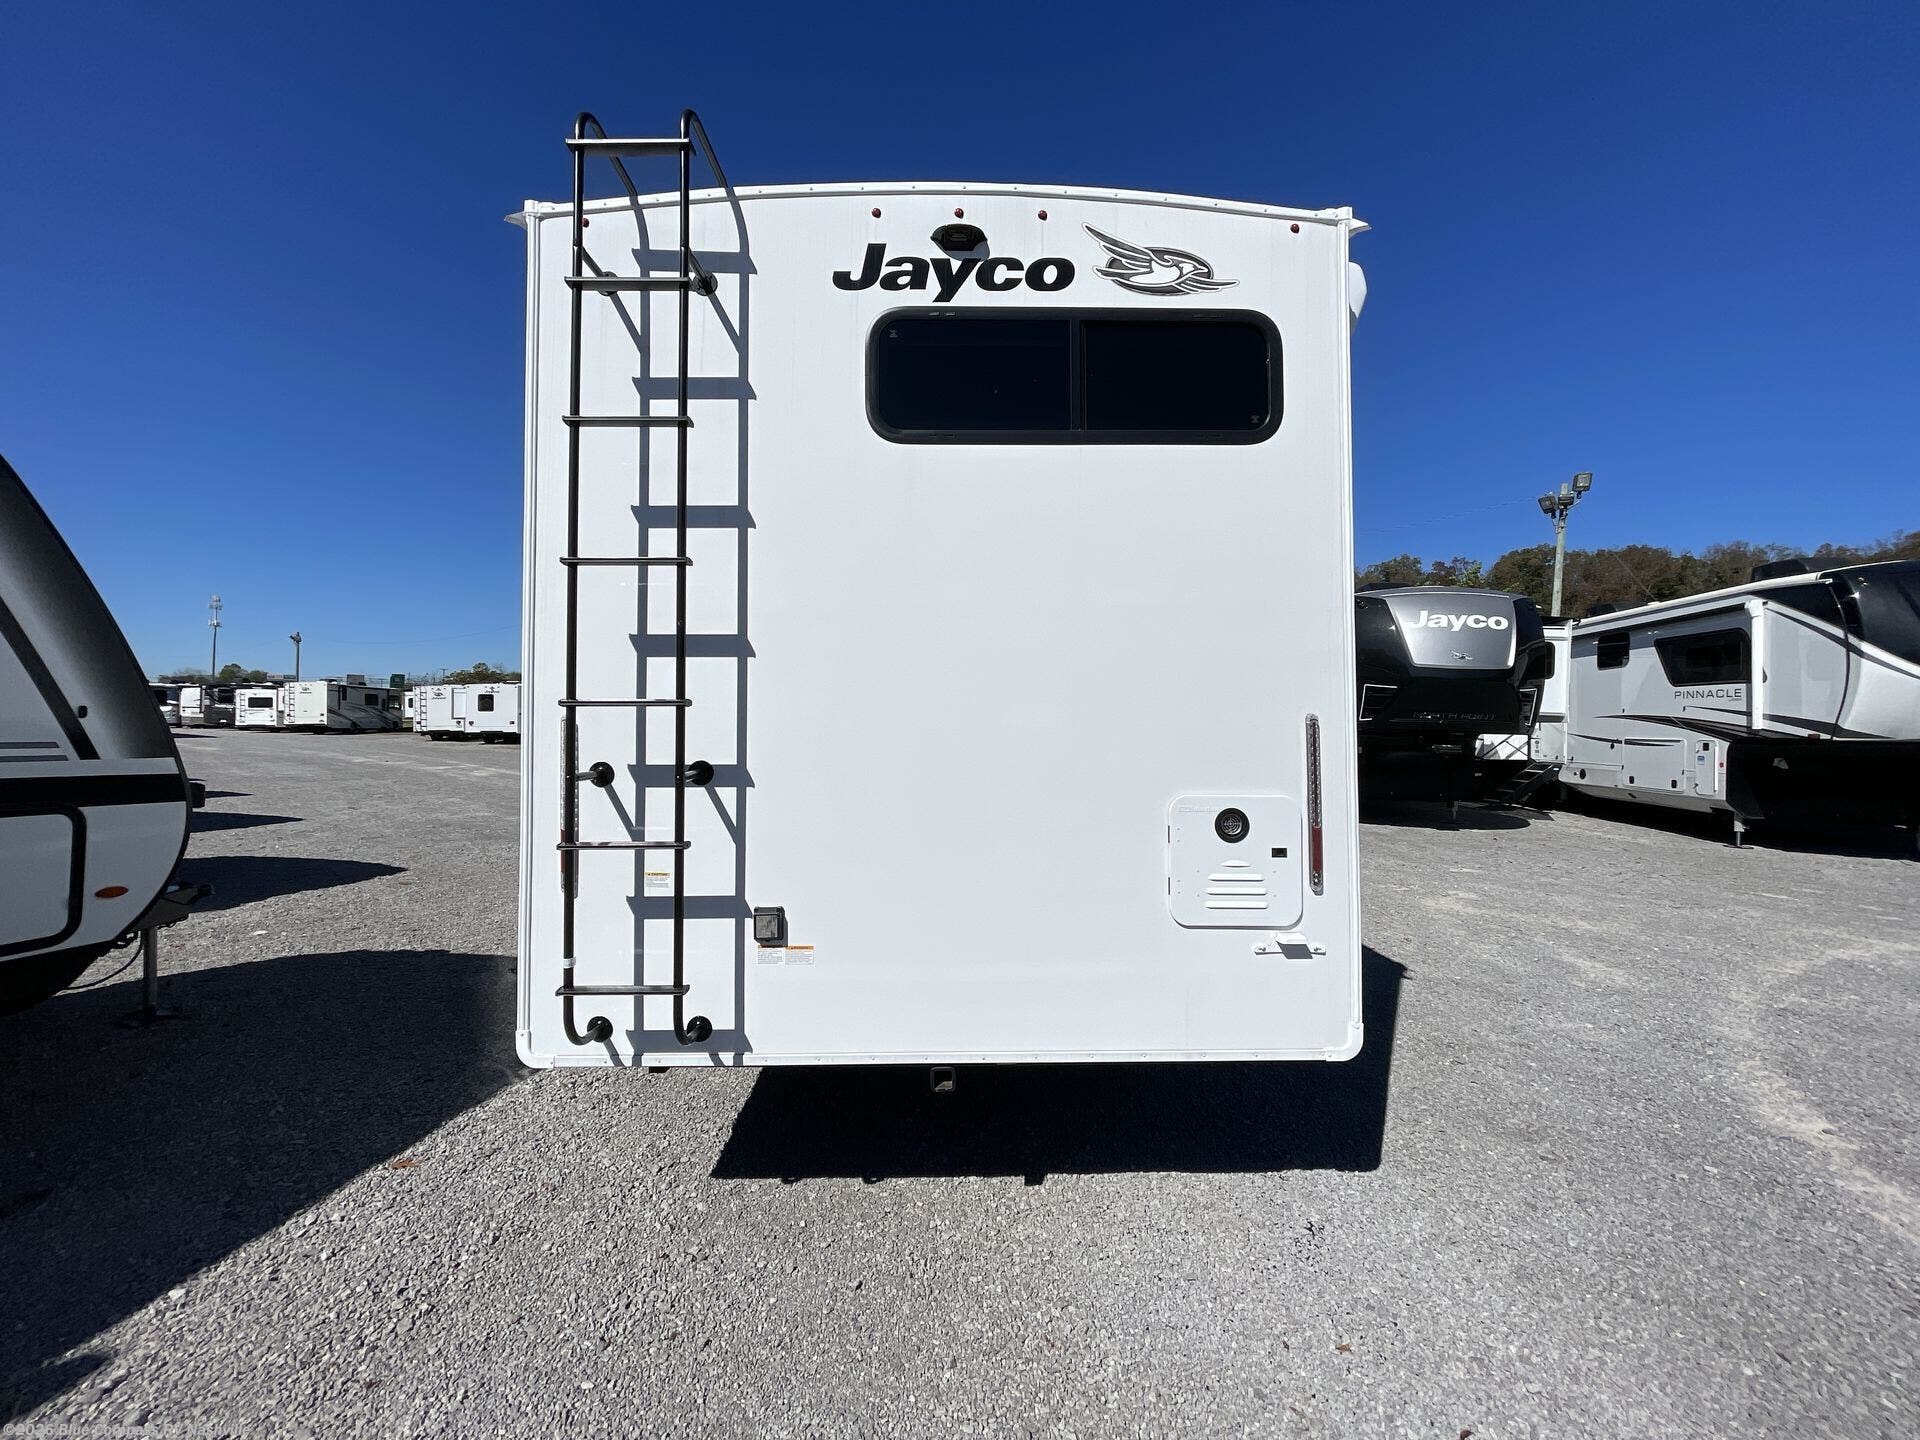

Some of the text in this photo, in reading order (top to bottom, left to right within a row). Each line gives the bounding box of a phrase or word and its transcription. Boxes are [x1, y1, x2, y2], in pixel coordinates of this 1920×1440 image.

[832, 243, 1075, 303] Jayco
[1407, 610, 1509, 632] Jayco
[1674, 688, 1742, 699] PINNACLE
